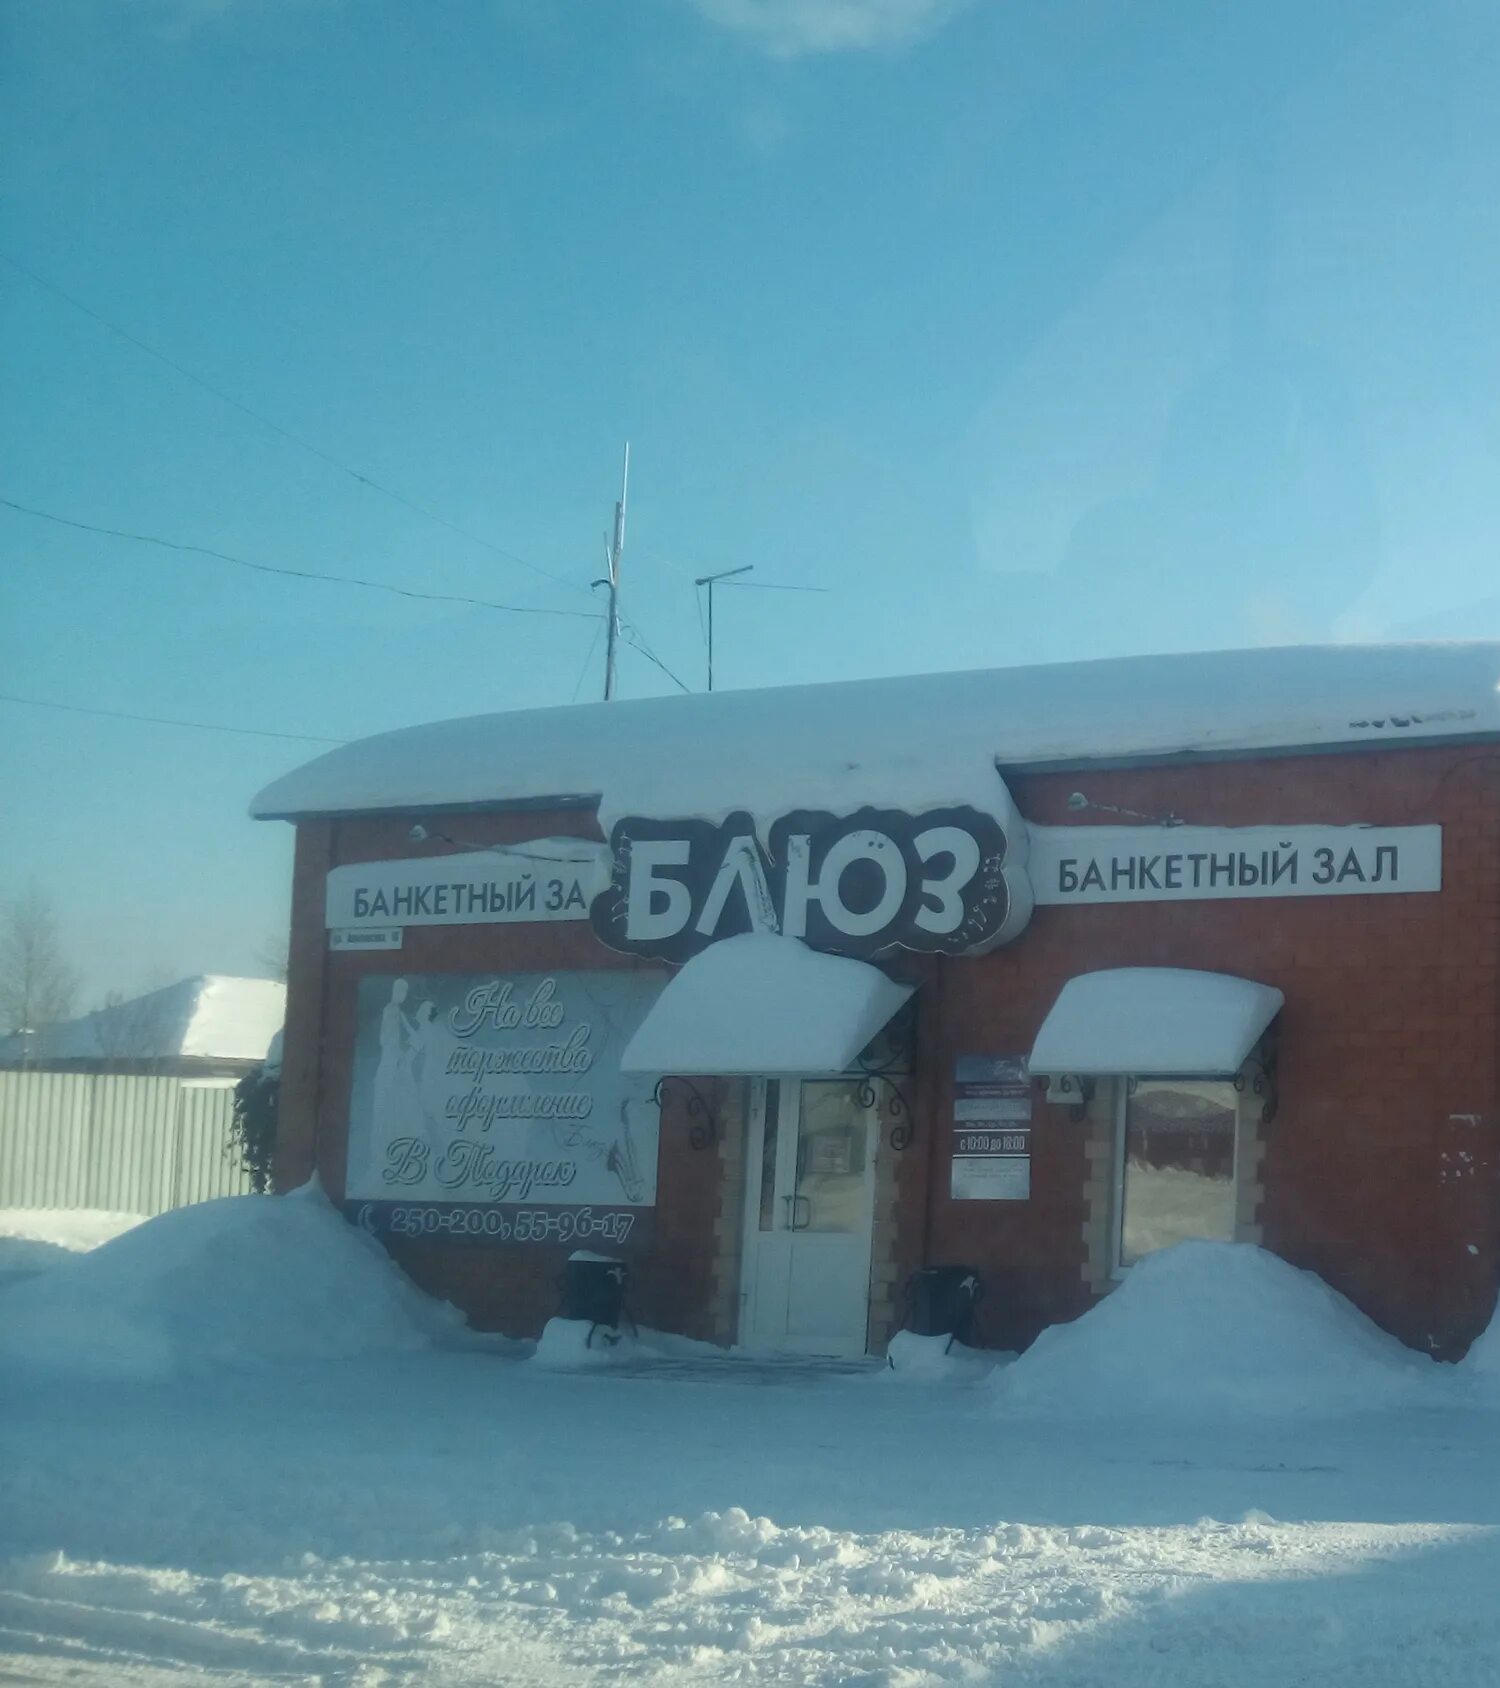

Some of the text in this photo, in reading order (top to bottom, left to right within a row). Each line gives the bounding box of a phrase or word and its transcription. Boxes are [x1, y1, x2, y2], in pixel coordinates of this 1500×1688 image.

[626, 825, 980, 940] БЛЮЗ
[1058, 841, 1399, 893] БАНКЕТНЫЙ ЗАЛ
[353, 873, 587, 918] БАНКЕТНЫЙ ЗА
[451, 980, 523, 1038] На
[446, 1023, 594, 1084] торжества
[446, 1087, 594, 1133] оформление
[382, 1136, 577, 1201] В Подарок
[391, 1206, 635, 1243] 250-200, 55-96-17
